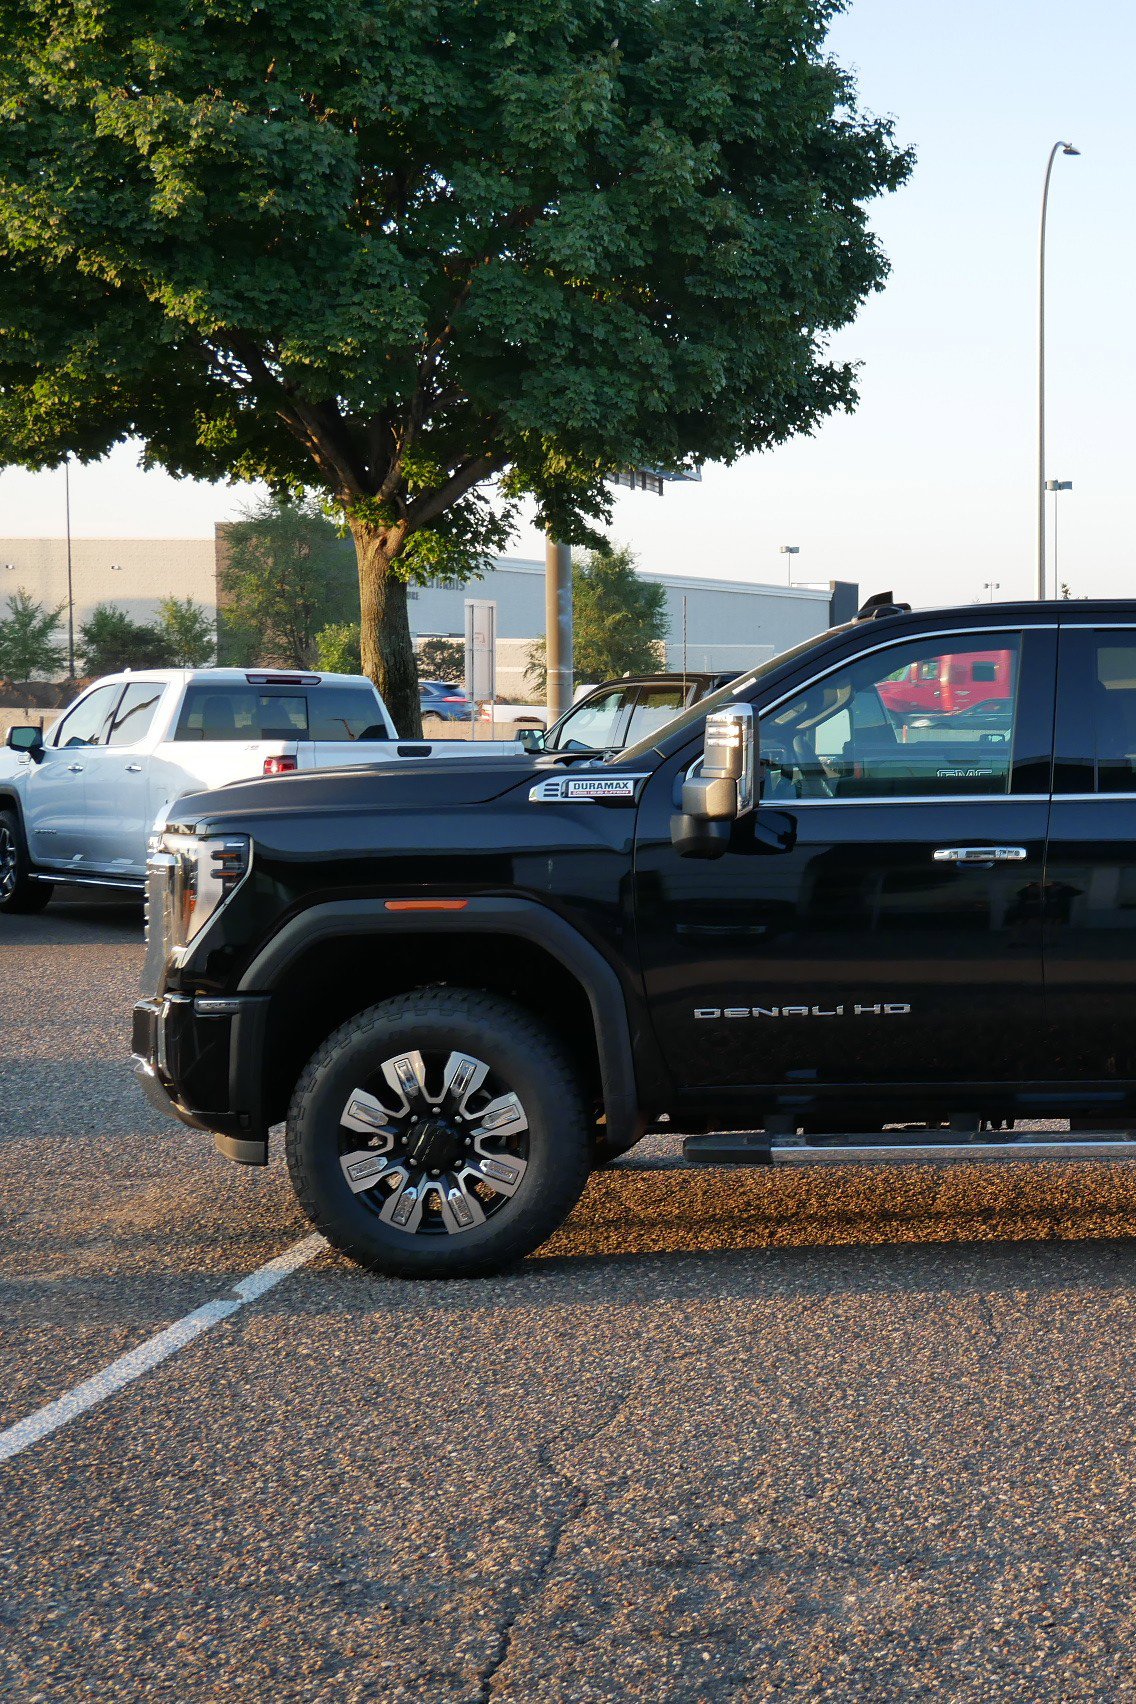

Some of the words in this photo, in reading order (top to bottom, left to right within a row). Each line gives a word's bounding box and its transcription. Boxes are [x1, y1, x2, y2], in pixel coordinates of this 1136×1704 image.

[573, 781, 630, 790] DURAMAX
[693, 1004, 844, 1019] DENALI
[853, 1003, 912, 1016] HD
